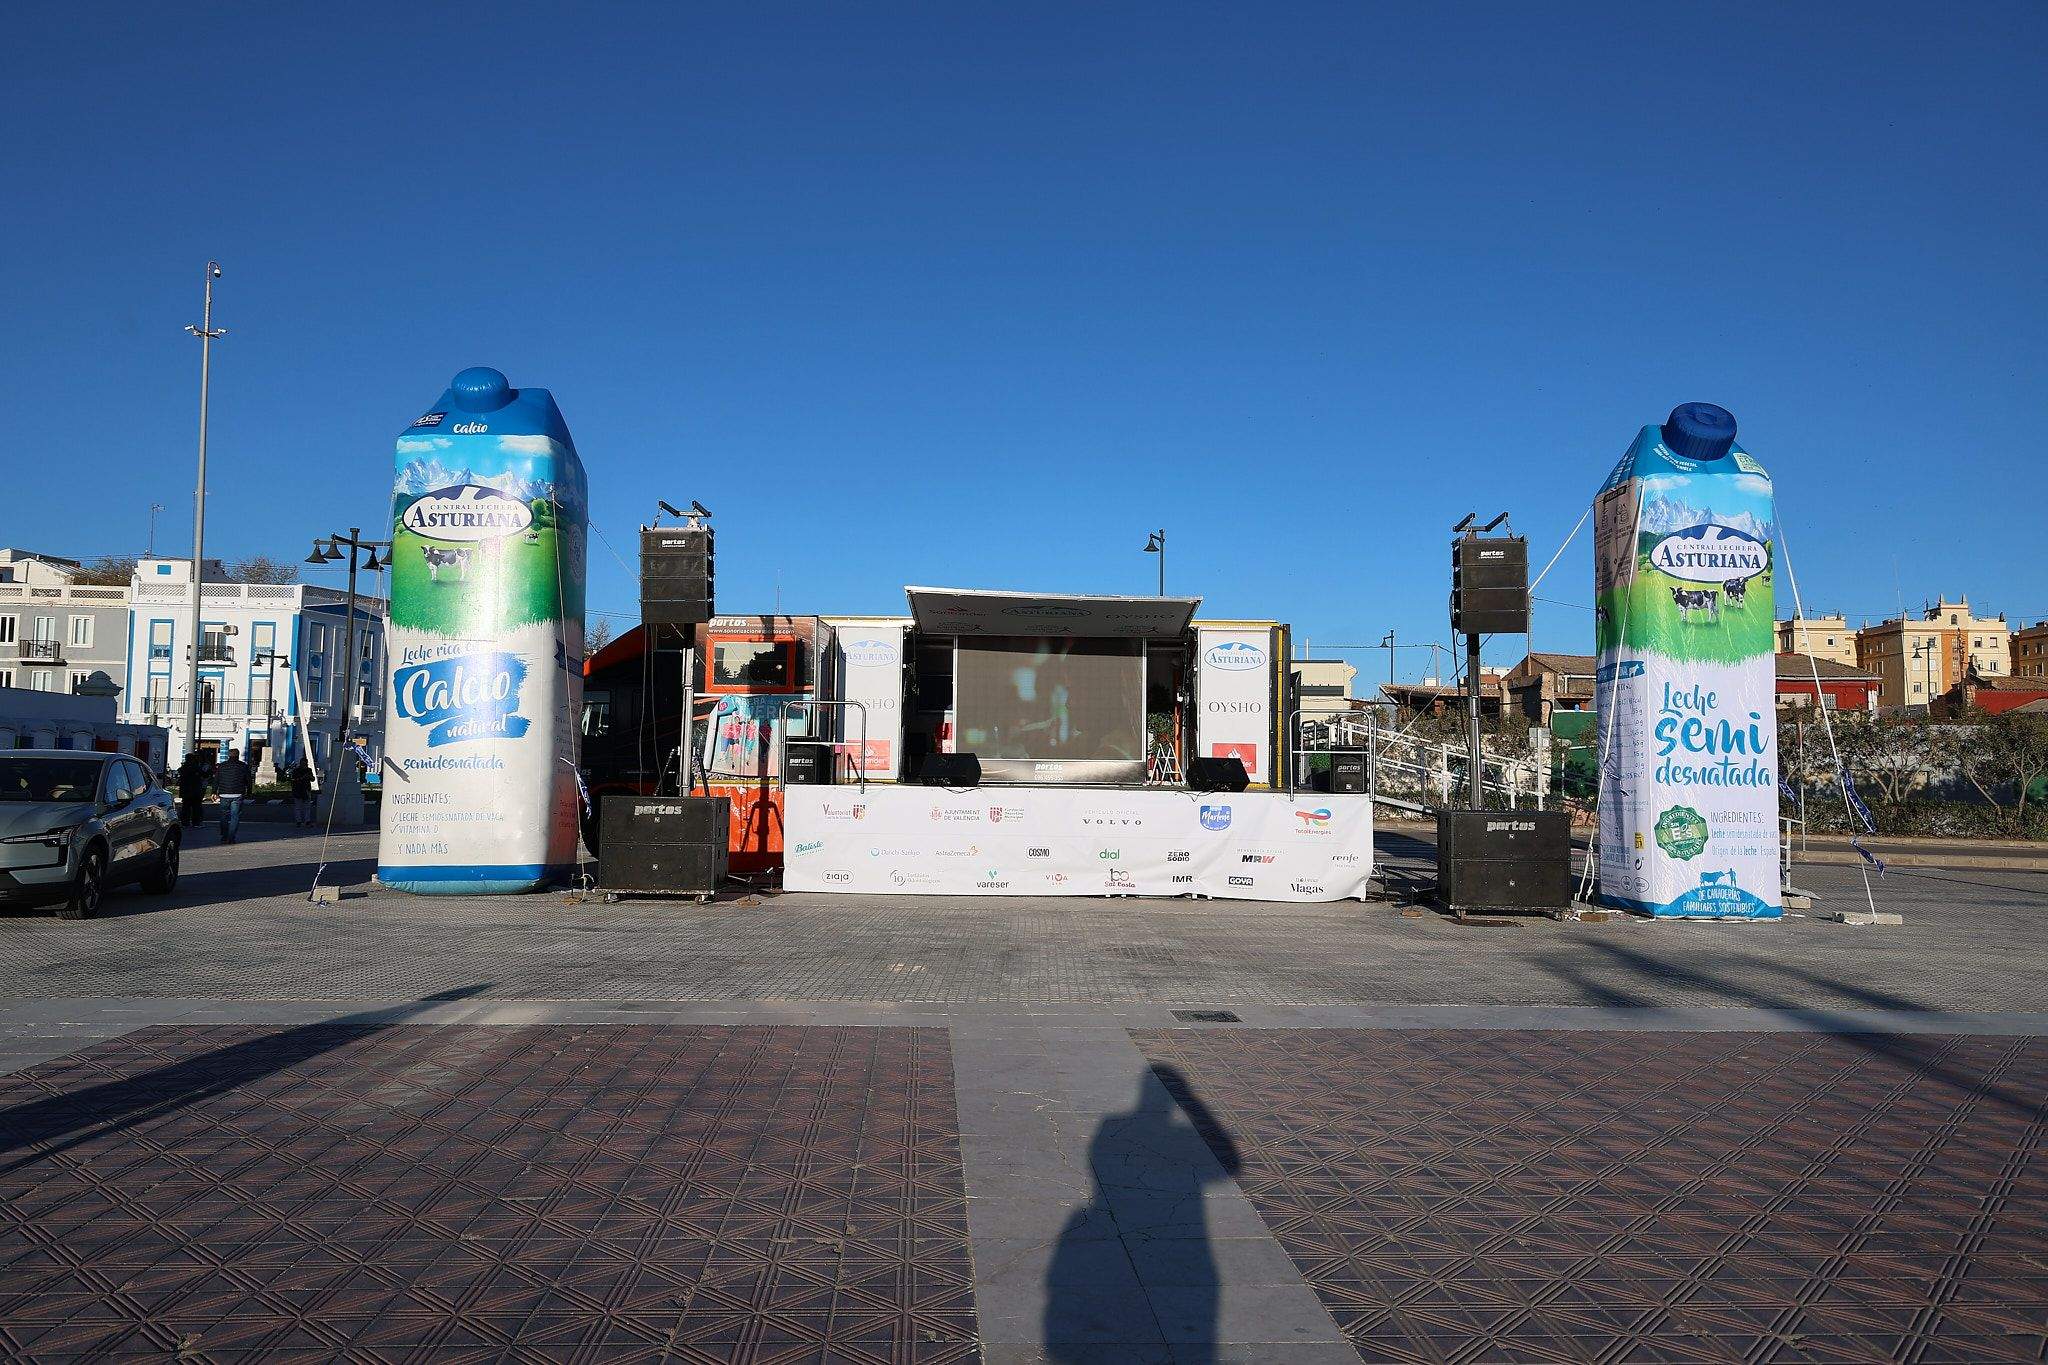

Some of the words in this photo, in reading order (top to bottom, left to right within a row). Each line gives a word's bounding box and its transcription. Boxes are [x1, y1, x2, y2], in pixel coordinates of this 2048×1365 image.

[409, 505, 523, 528] ASTURIANA
[1718, 544, 1758, 552] LECHERA
[1658, 544, 1762, 569] ASTURIANA
[402, 644, 432, 666] Leche
[436, 642, 462, 656] rica
[1209, 651, 1262, 664] ASTURIANA
[402, 665, 510, 718] Calcio
[1658, 681, 1718, 718] Leche
[1208, 701, 1262, 713] OYSHO
[1654, 712, 1769, 756] semi
[403, 754, 506, 771] semidesnatada
[1654, 755, 1773, 788] desnatada
[391, 792, 452, 805] INGREDIENTES:
[634, 803, 683, 816] portos
[399, 812, 418, 822] LECHE
[1082, 818, 1142, 826] VOLVO
[1710, 811, 1765, 824] INGREDIENTES:
[1486, 820, 1536, 832] portos
[405, 842, 427, 854] NADA
[935, 849, 971, 857] AstraZeneca
[1028, 848, 1050, 857] COSMO
[1099, 848, 1120, 859] dial
[1241, 854, 1275, 863] MRW
[1331, 853, 1359, 863] renfe
[826, 873, 849, 882] ziaja
[1172, 875, 1193, 883] IMR
[976, 880, 1009, 888] vareser
[1290, 883, 1324, 894] Magas
[1682, 901, 1717, 913] FAMILIARES
[1718, 902, 1755, 914] SOSTENIBLES
